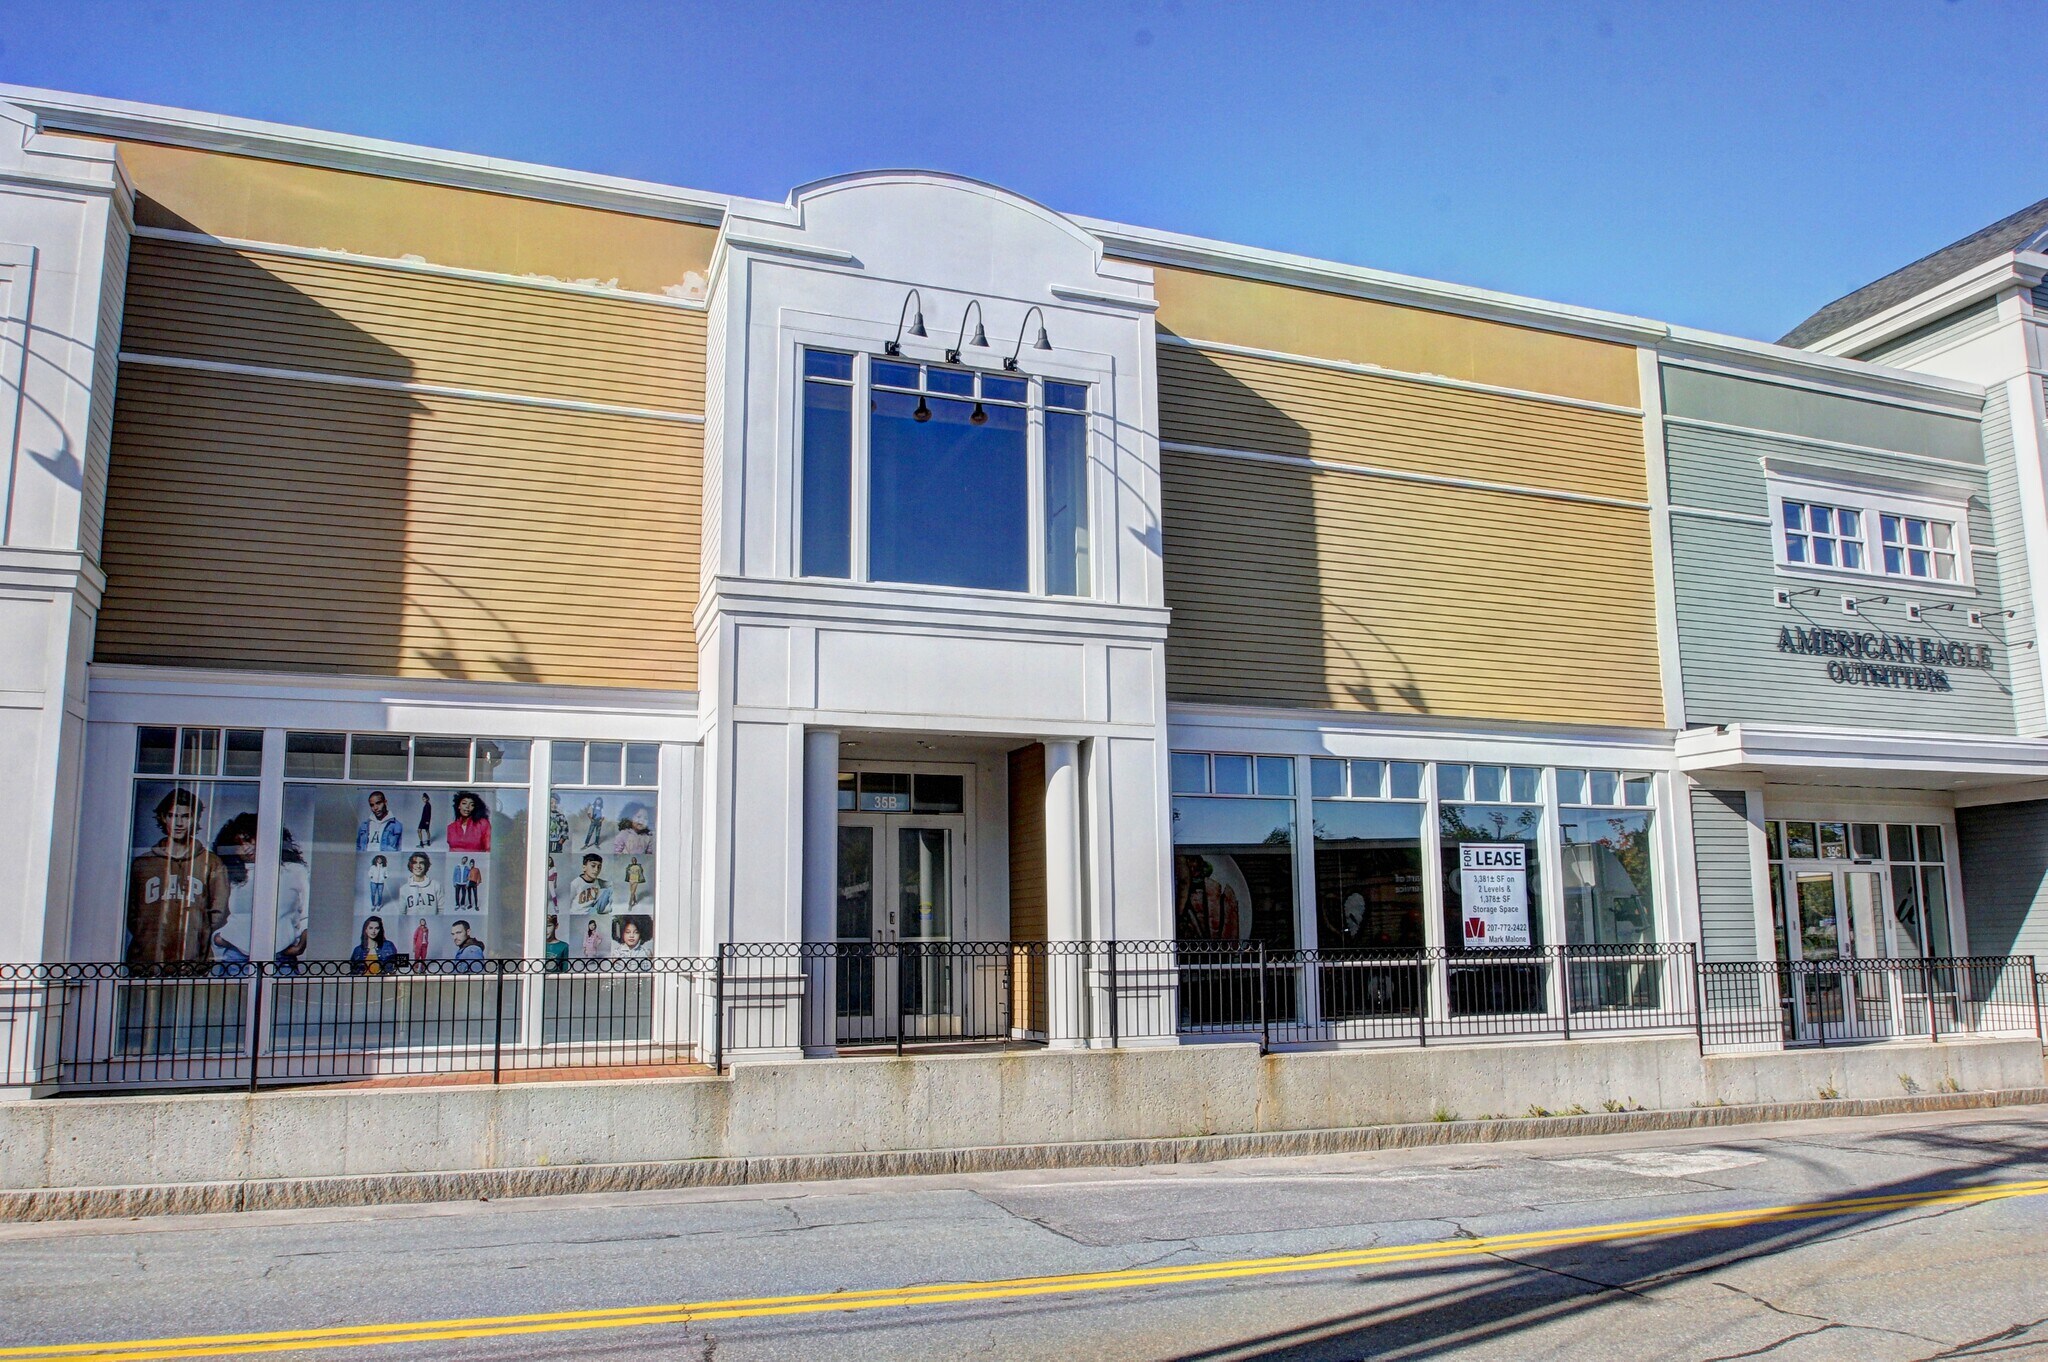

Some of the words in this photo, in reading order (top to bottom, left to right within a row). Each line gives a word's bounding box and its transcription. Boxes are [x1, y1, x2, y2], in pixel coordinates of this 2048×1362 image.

[1777, 625, 1914, 663] AMERICAN
[1917, 637, 1992, 669] EAGLE
[1827, 660, 1952, 692] OUTFITTERS
[874, 796, 897, 808] 35B
[1463, 849, 1472, 867] FOR
[1826, 846, 1841, 857] 35C
[1476, 851, 1522, 866] LEASE
[1496, 875, 1505, 883] SF
[145, 875, 203, 904] GAP
[1478, 885, 1483, 893] 2
[1506, 885, 1511, 893] &
[407, 893, 435, 908] GAP
[1502, 895, 1511, 903] SF
[1472, 905, 1498, 914] Storage
[1498, 905, 1519, 914] Space
